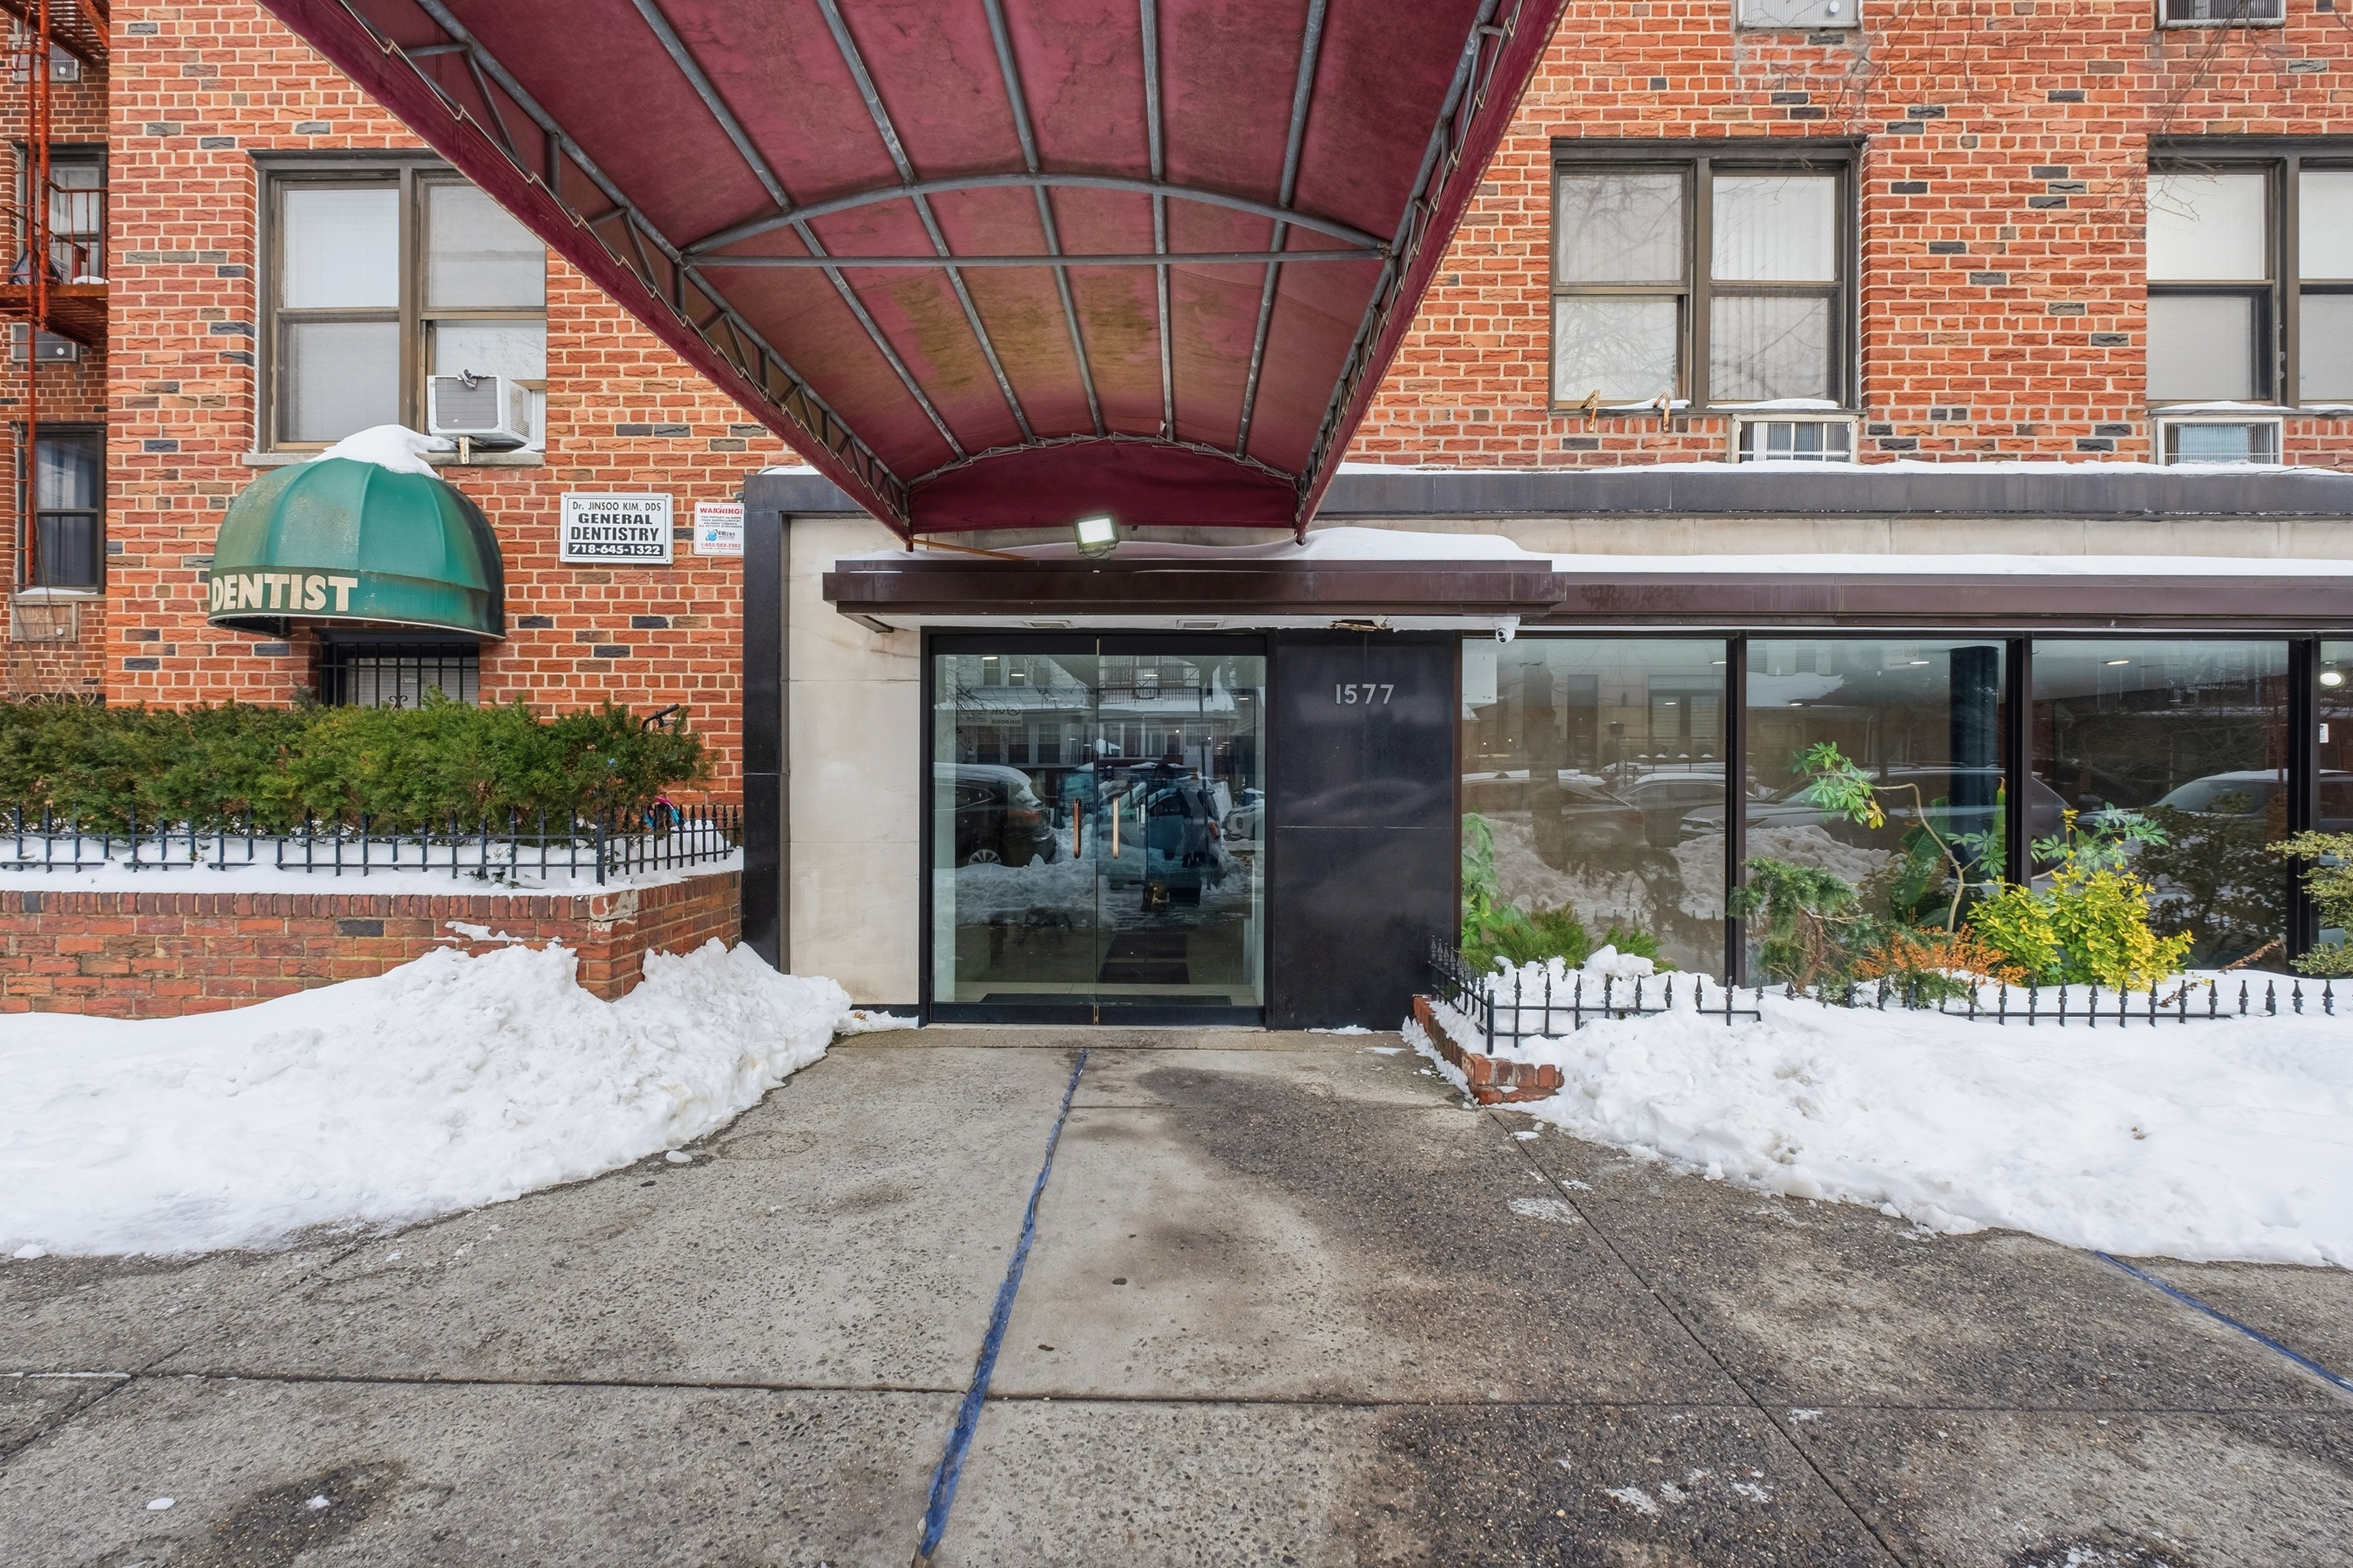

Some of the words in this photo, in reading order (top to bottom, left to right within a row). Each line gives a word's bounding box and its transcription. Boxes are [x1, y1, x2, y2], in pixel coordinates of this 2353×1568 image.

[645, 503, 661, 511] DDS
[578, 513, 652, 524] GENERAL
[571, 527, 659, 541] DENTISTRY
[572, 544, 660, 555] 718-645-1322
[211, 573, 358, 612] DENTIST
[1336, 684, 1395, 704] 1577
